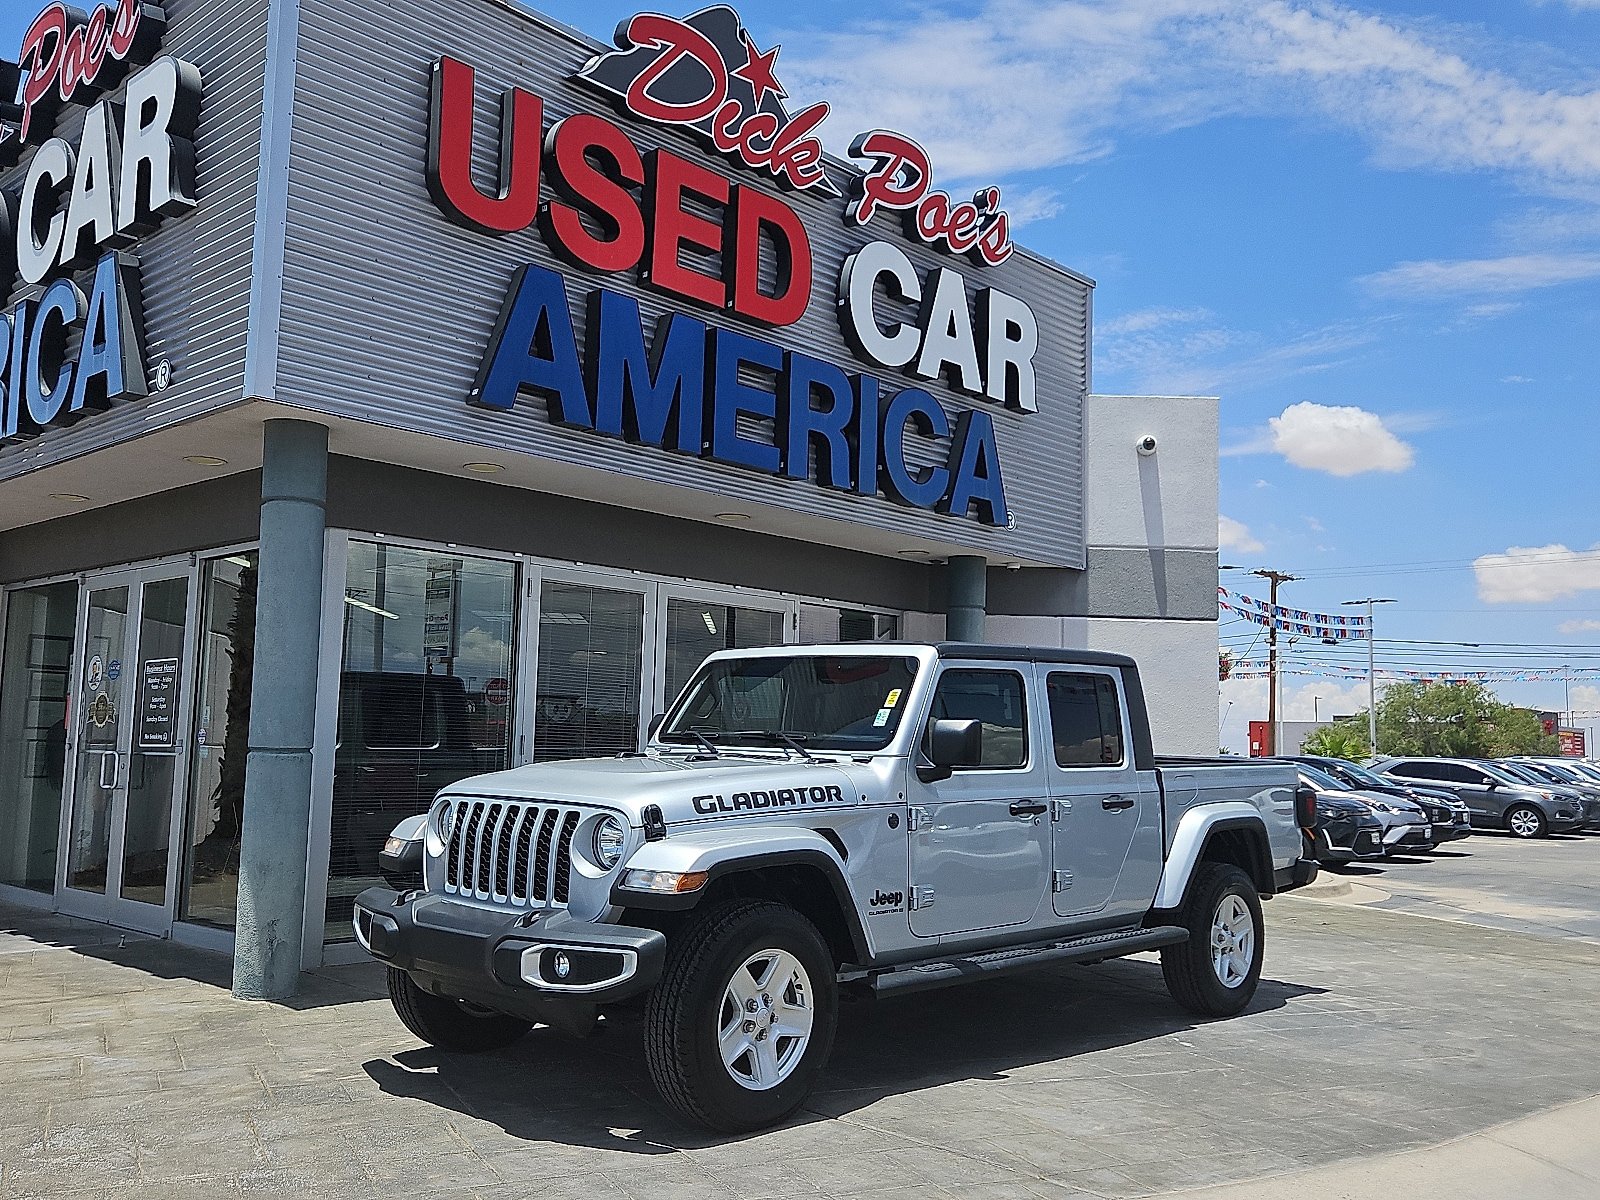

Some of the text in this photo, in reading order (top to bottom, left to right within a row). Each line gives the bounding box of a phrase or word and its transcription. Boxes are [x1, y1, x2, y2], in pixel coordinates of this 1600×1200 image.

[17, 56, 186, 284] CAR
[18, 0, 141, 143] Poes
[618, 11, 1015, 268] Dick Poe's
[430, 55, 1040, 414] USED CAR
[470, 263, 1009, 528] AMERICA
[691, 783, 845, 815] GLADIATOR
[869, 889, 904, 907] Jeep
